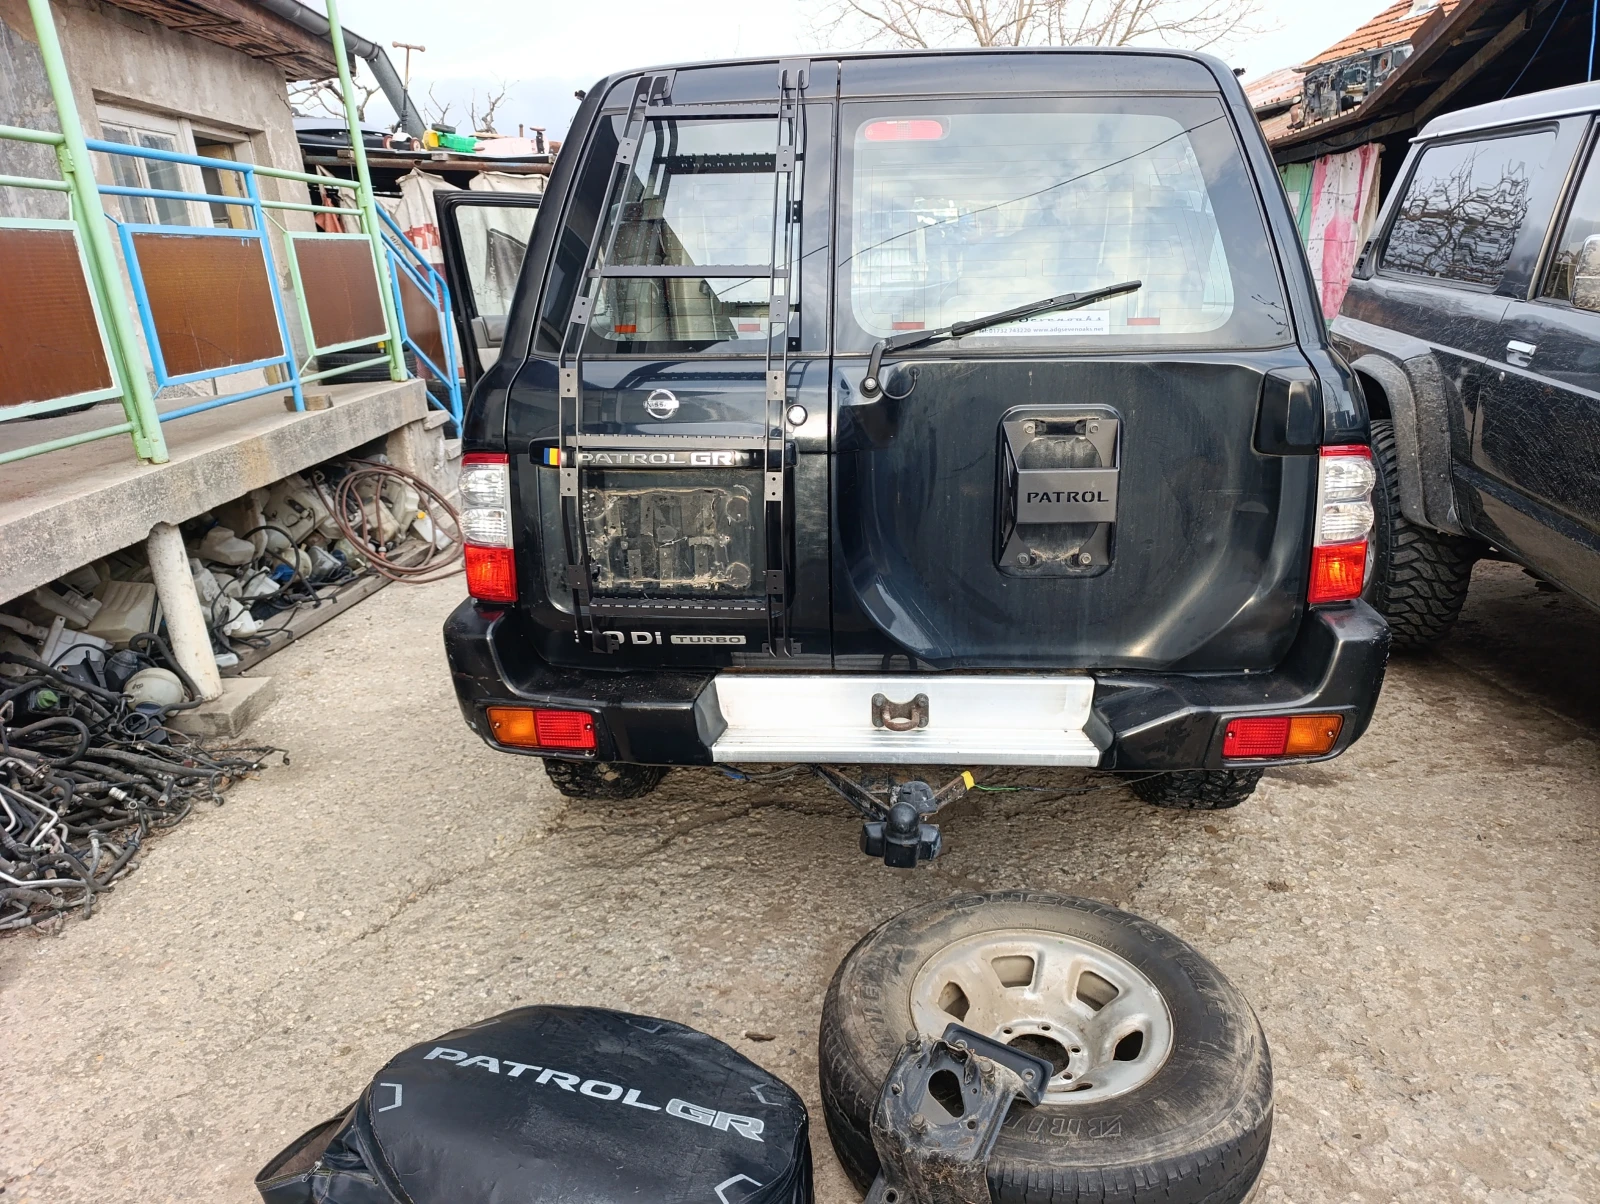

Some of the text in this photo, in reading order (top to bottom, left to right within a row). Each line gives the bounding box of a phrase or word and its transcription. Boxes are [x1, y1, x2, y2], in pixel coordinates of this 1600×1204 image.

[581, 451, 734, 466] PATROL GR
[1026, 491, 1109, 503] PATROL
[630, 631, 663, 645] Di
[676, 635, 741, 644] TURBO
[423, 1046, 765, 1143] PATROL GR
